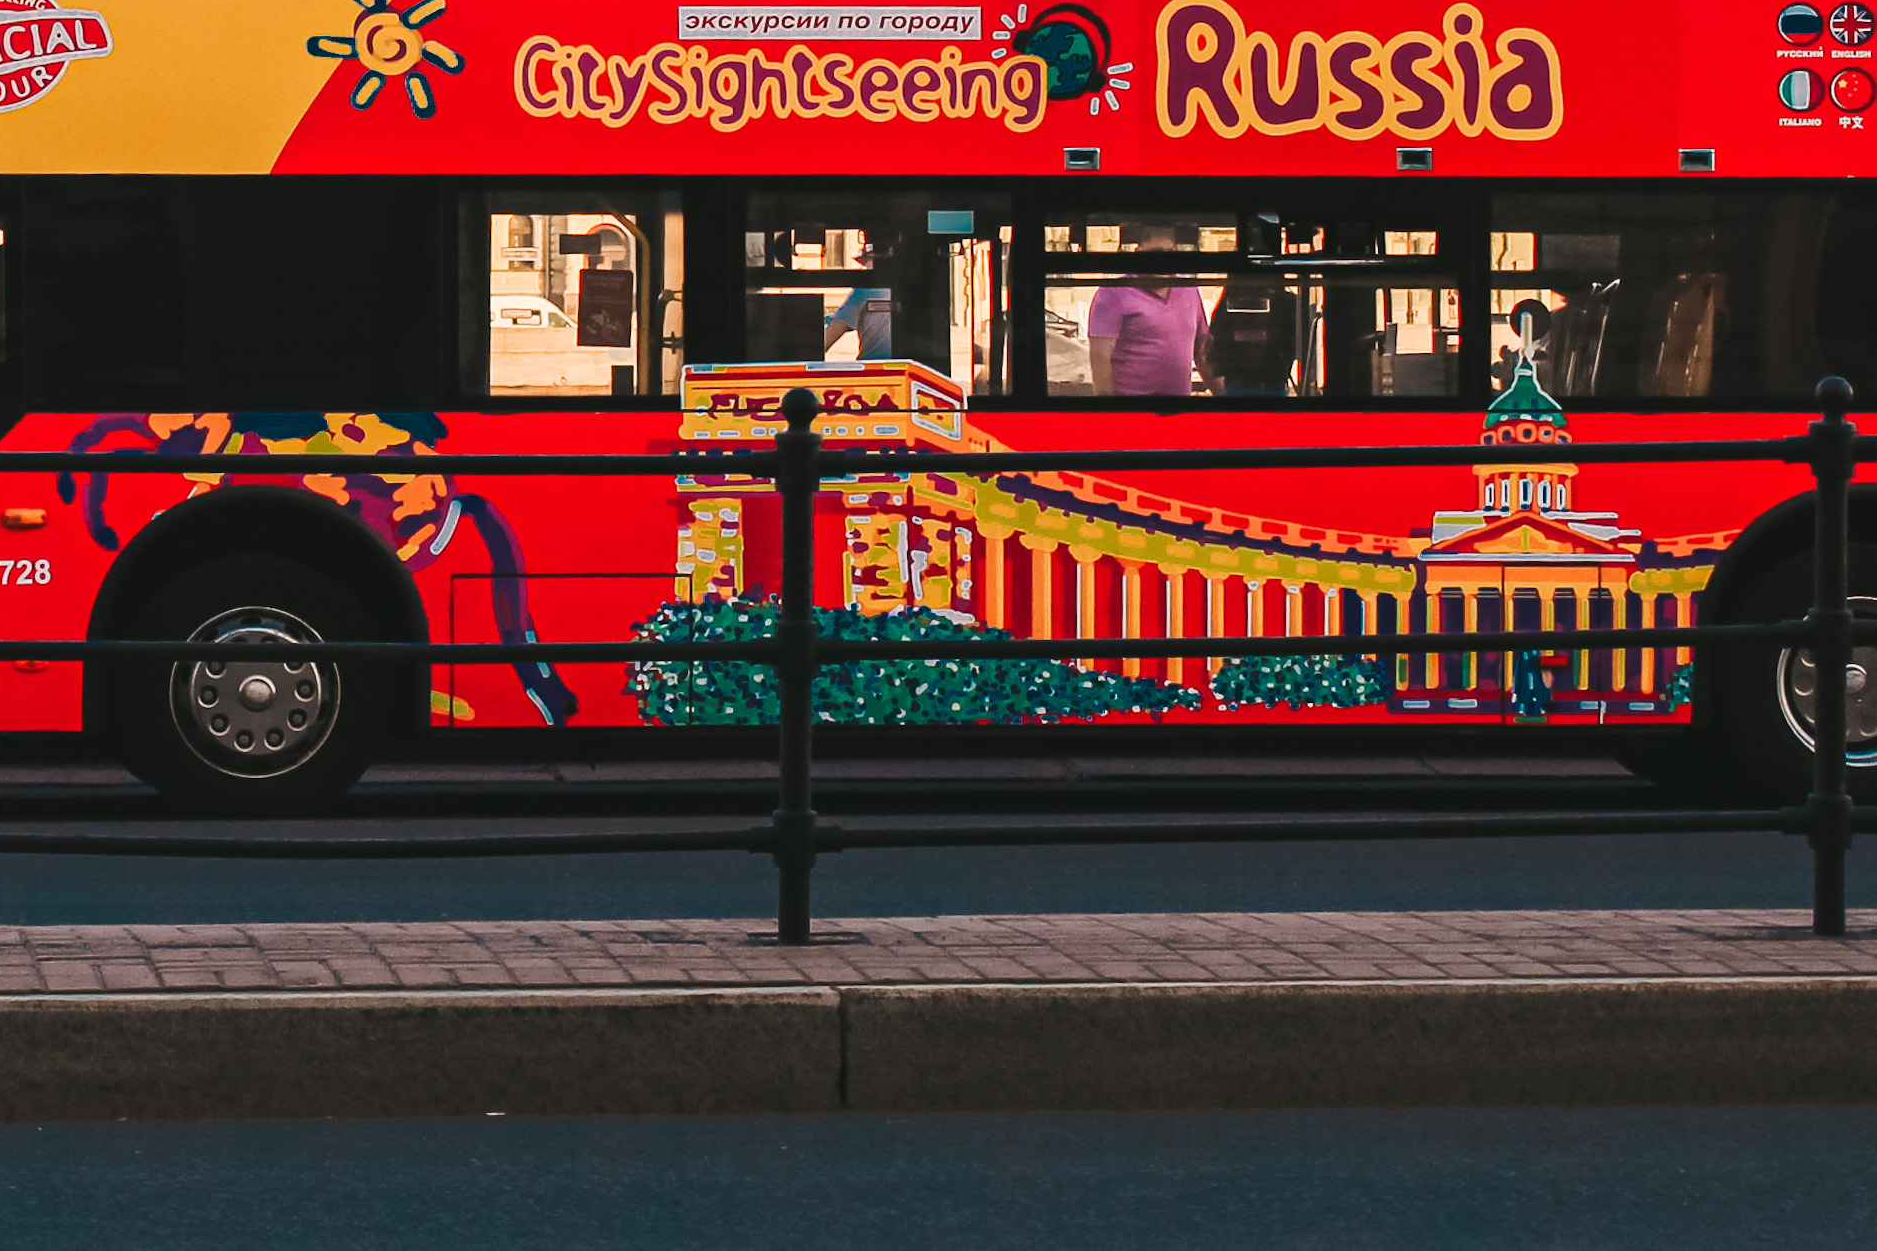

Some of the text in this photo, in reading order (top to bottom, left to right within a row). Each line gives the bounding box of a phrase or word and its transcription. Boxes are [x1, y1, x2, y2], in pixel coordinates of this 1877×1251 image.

[684, 13, 975, 34] экскурсии по городу
[1776, 46, 1824, 58] РУССКИЙ
[1831, 50, 1872, 59] ENGLISH
[515, 35, 1047, 132] CitySightseeing
[1778, 118, 1822, 127] ITALIANO
[1838, 115, 1865, 129] 中文
